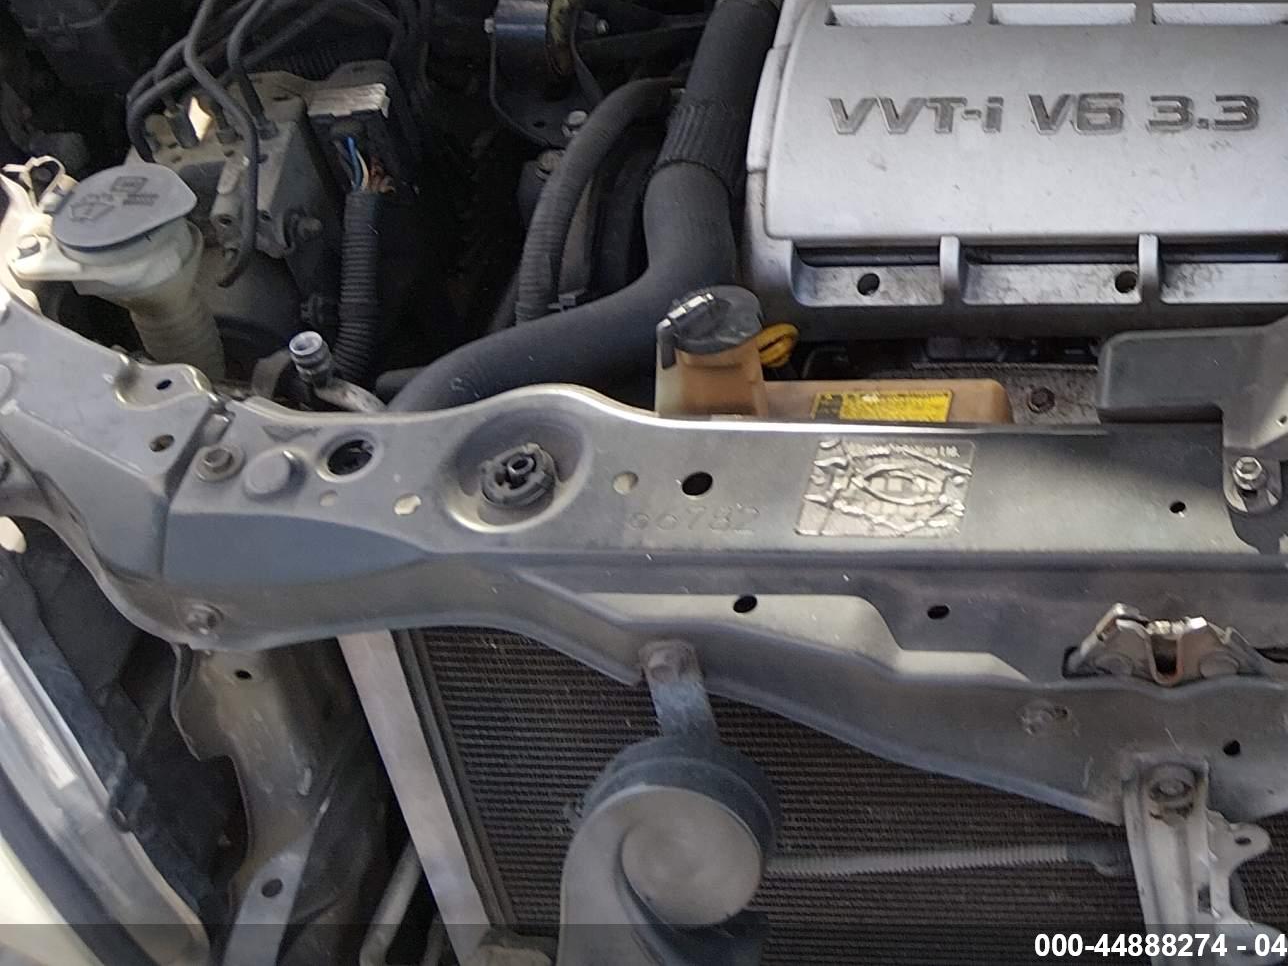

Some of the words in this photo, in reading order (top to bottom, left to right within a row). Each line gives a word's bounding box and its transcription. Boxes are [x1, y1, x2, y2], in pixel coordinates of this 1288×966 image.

[828, 96, 1004, 135] VVT-i
[1028, 92, 1125, 135] V6
[1146, 94, 1260, 133] 3.3
